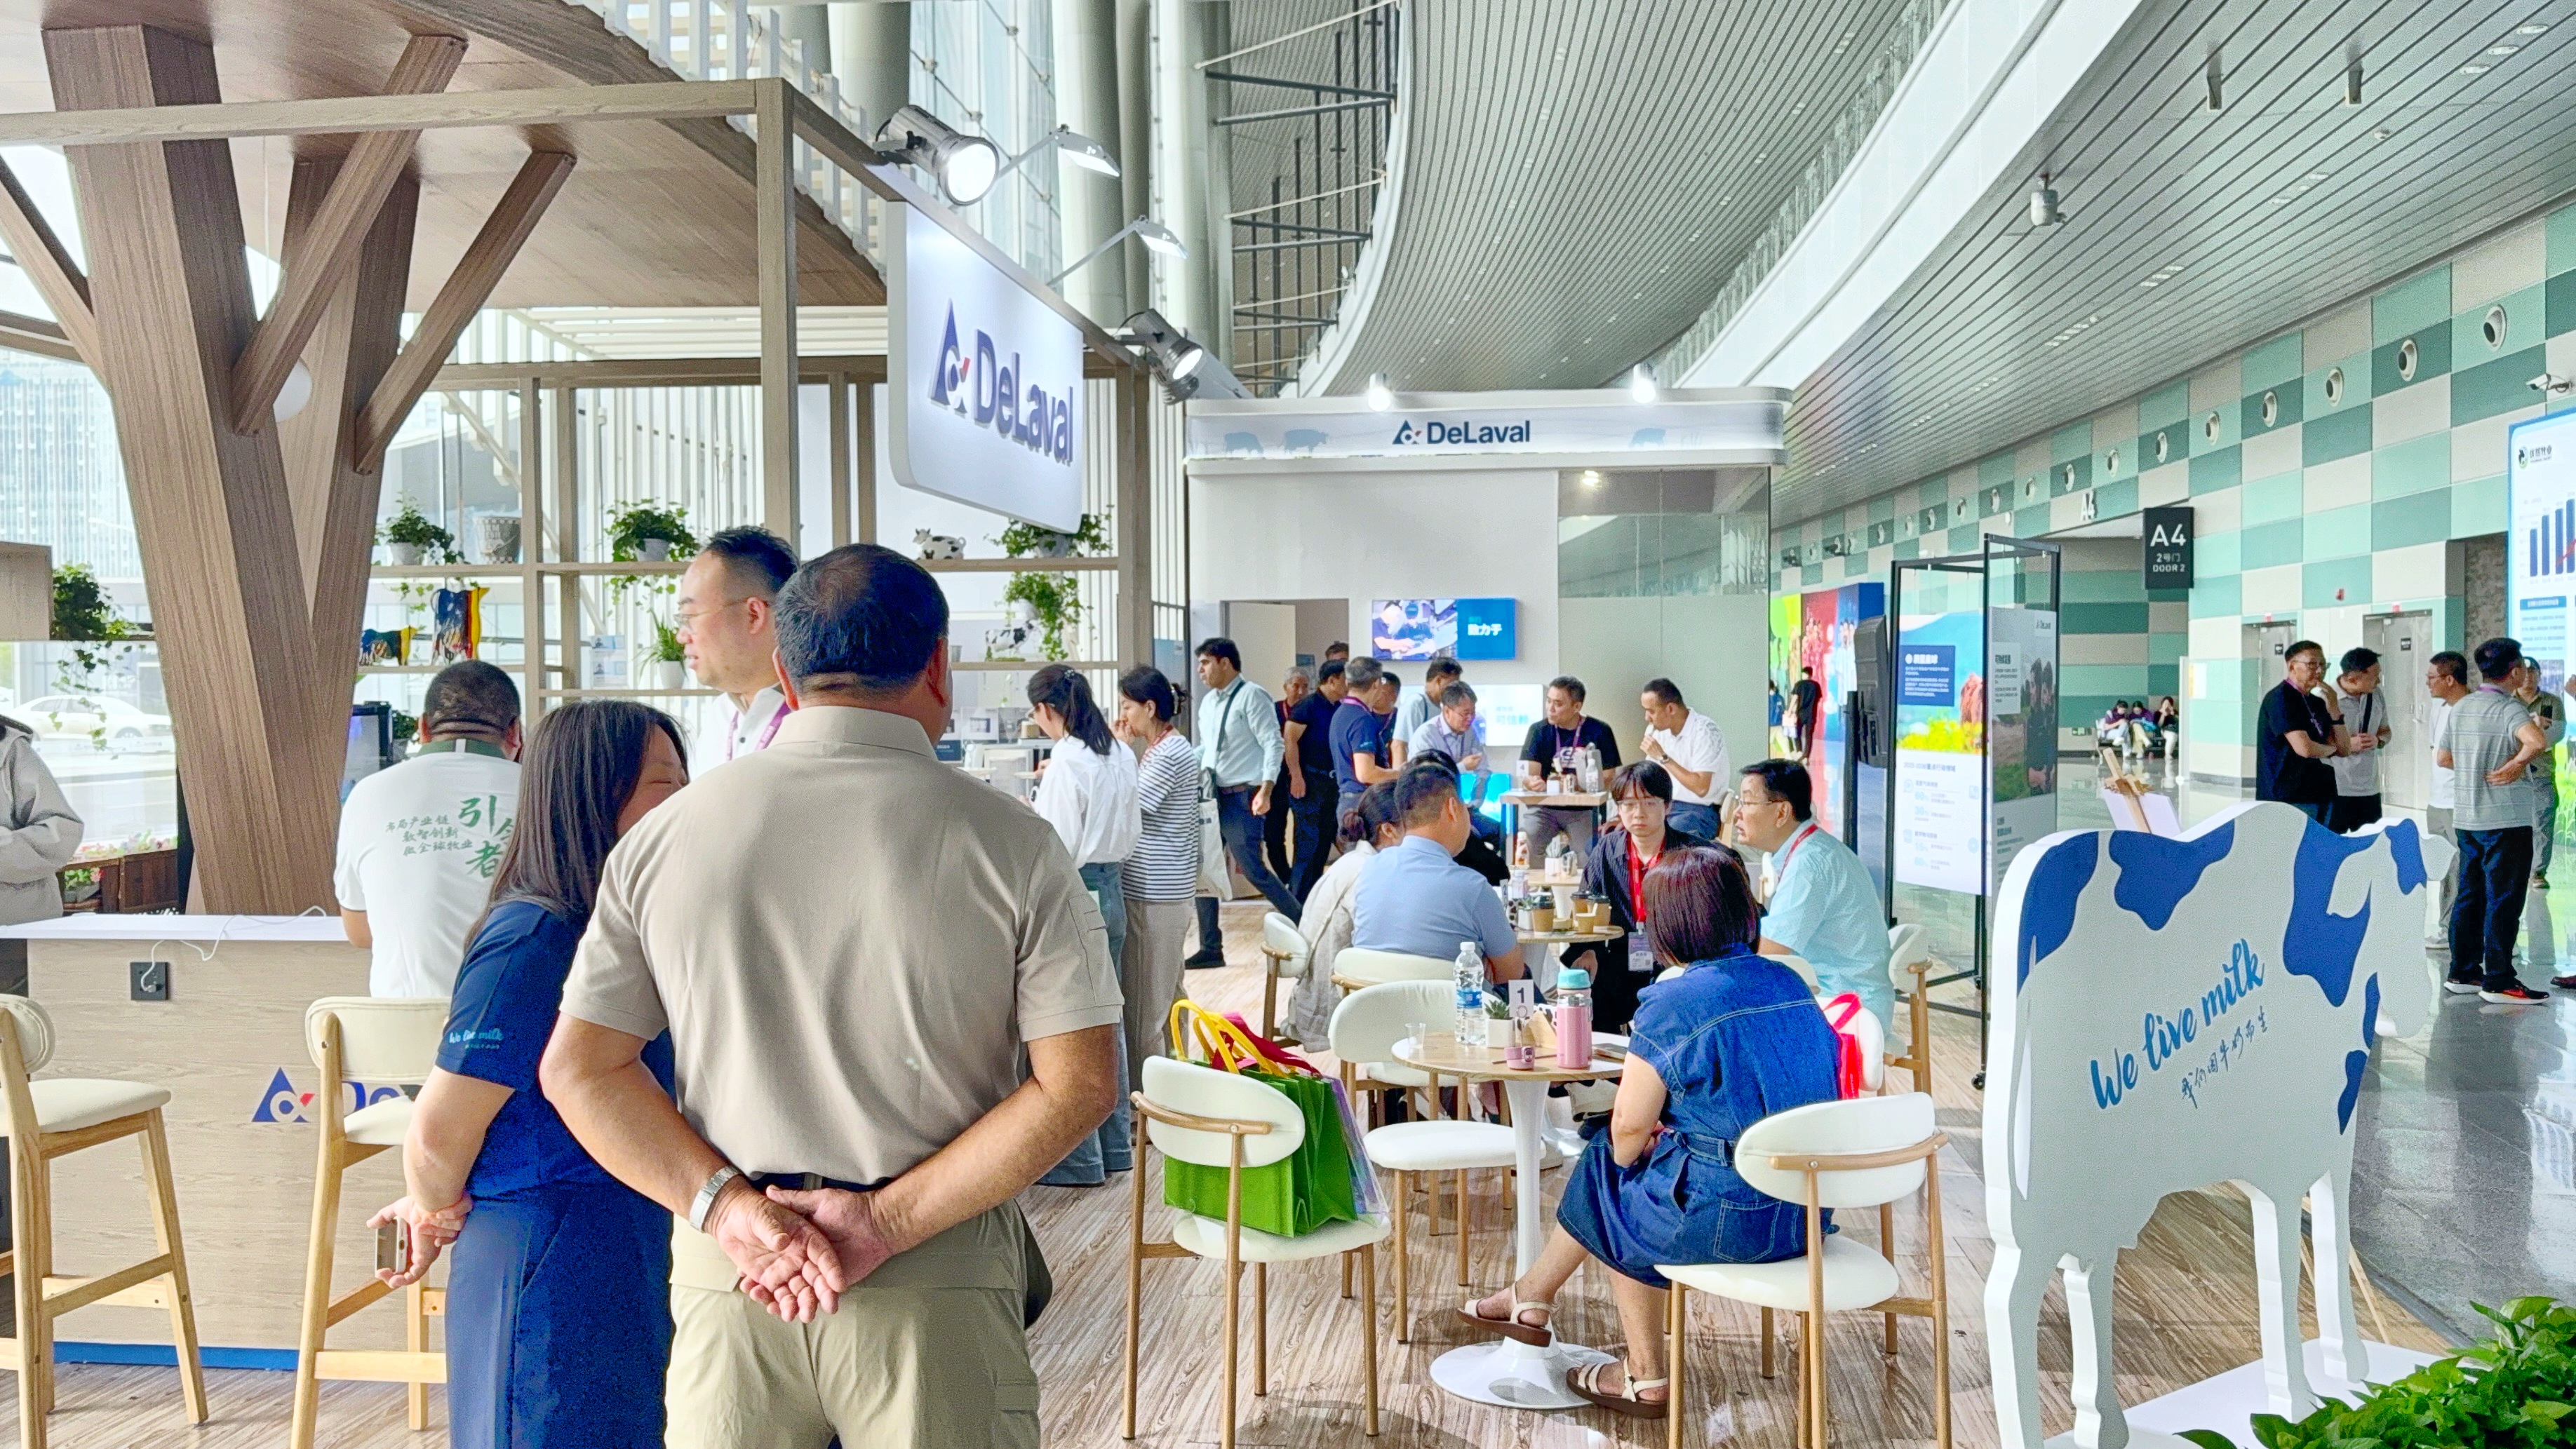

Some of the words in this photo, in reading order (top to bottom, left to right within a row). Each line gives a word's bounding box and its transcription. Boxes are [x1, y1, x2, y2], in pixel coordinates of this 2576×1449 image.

[974, 328, 1073, 466] DeLaval
[1426, 420, 1530, 444] DeLaval
[2149, 524, 2187, 547] A4
[2152, 564, 2178, 572] DOOR
[2180, 564, 2186, 572] 2
[1517, 987, 1525, 1004] 1
[2090, 1047, 2139, 1110] We
[2142, 1007, 2197, 1071] live
[2201, 938, 2265, 1027] milk
